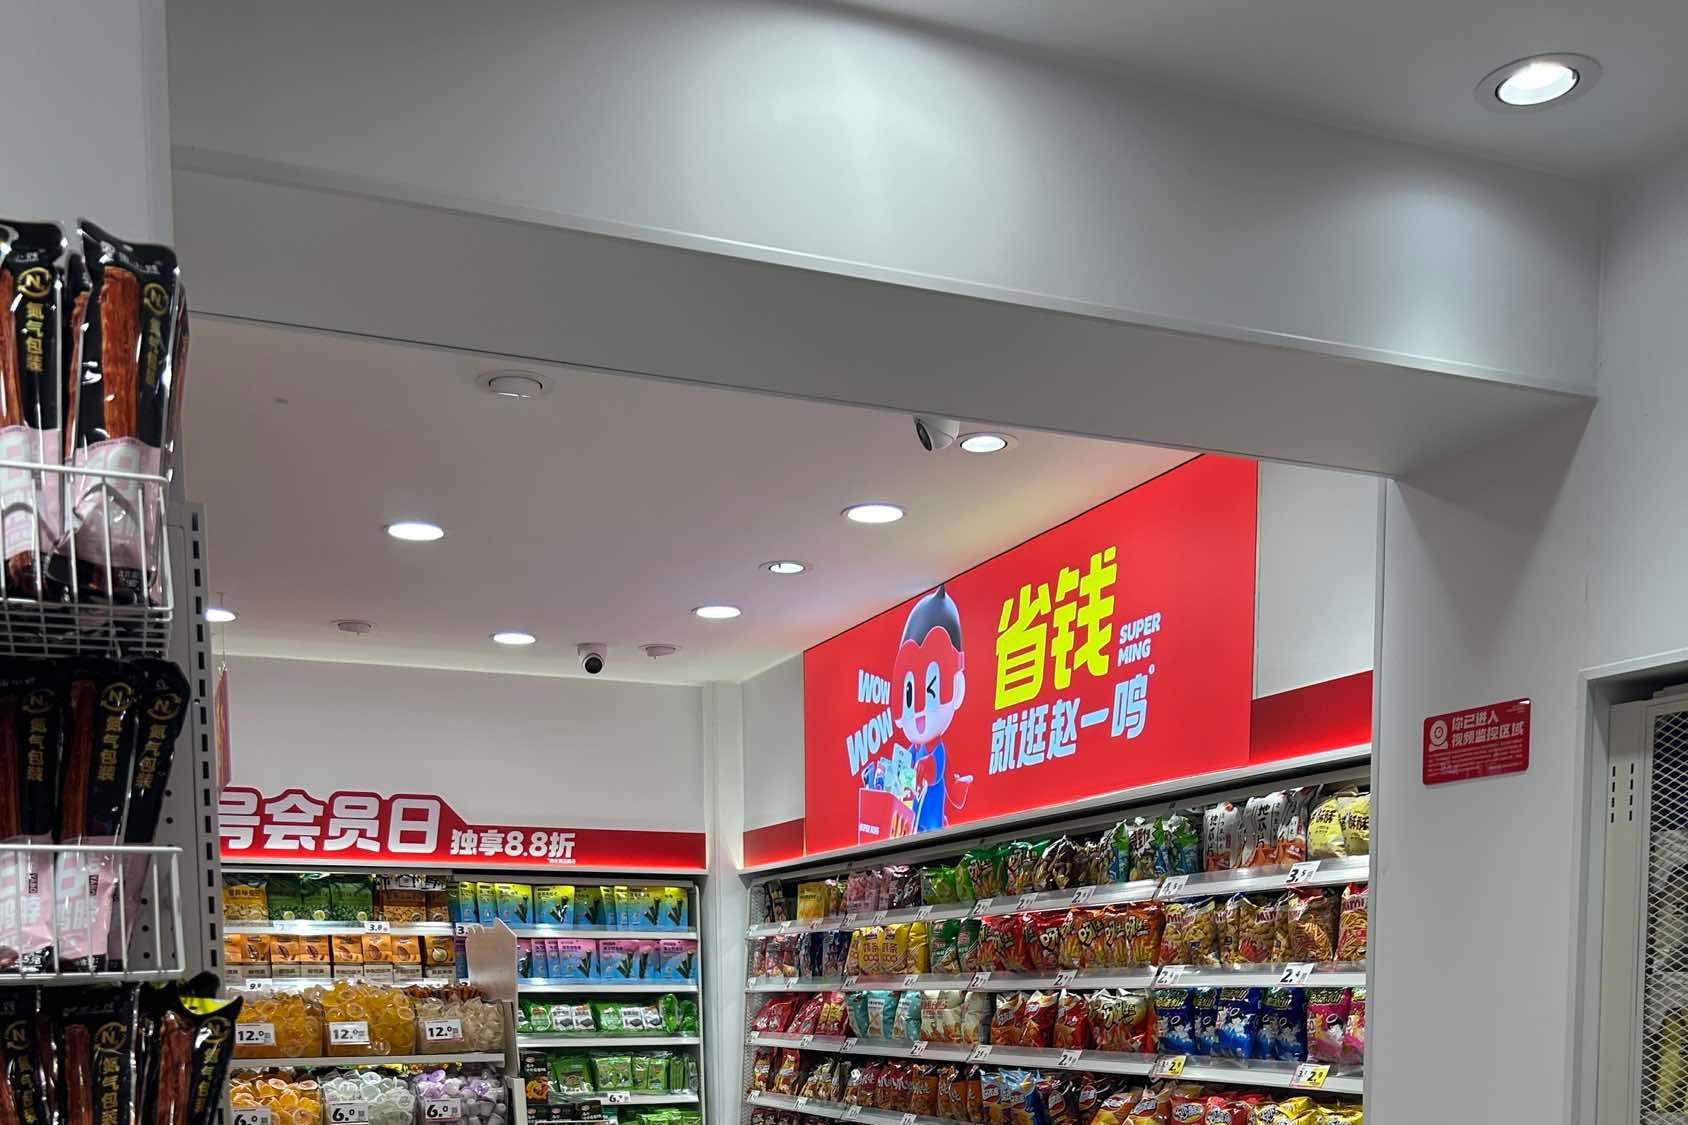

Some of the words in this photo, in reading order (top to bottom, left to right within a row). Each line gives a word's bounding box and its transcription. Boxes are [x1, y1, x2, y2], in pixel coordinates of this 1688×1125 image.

[995, 546, 1117, 711] 省钱
[1119, 612, 1161, 644] SUPER
[1117, 637, 1151, 667] MING
[858, 669, 891, 705] WOW
[989, 672, 1149, 776] 就逛赵一鸣
[846, 707, 894, 777] WOW
[450, 830, 575, 858] 独享8.8折
[1286, 868, 1306, 883] 3.5
[237, 1030, 264, 1041] 12.0
[333, 1029, 359, 1040] 12.0
[428, 1026, 453, 1037] 12.0
[1307, 1071, 1323, 1083] 2.9
[332, 1108, 355, 1121] 6.0
[426, 1105, 448, 1118] 6.0
